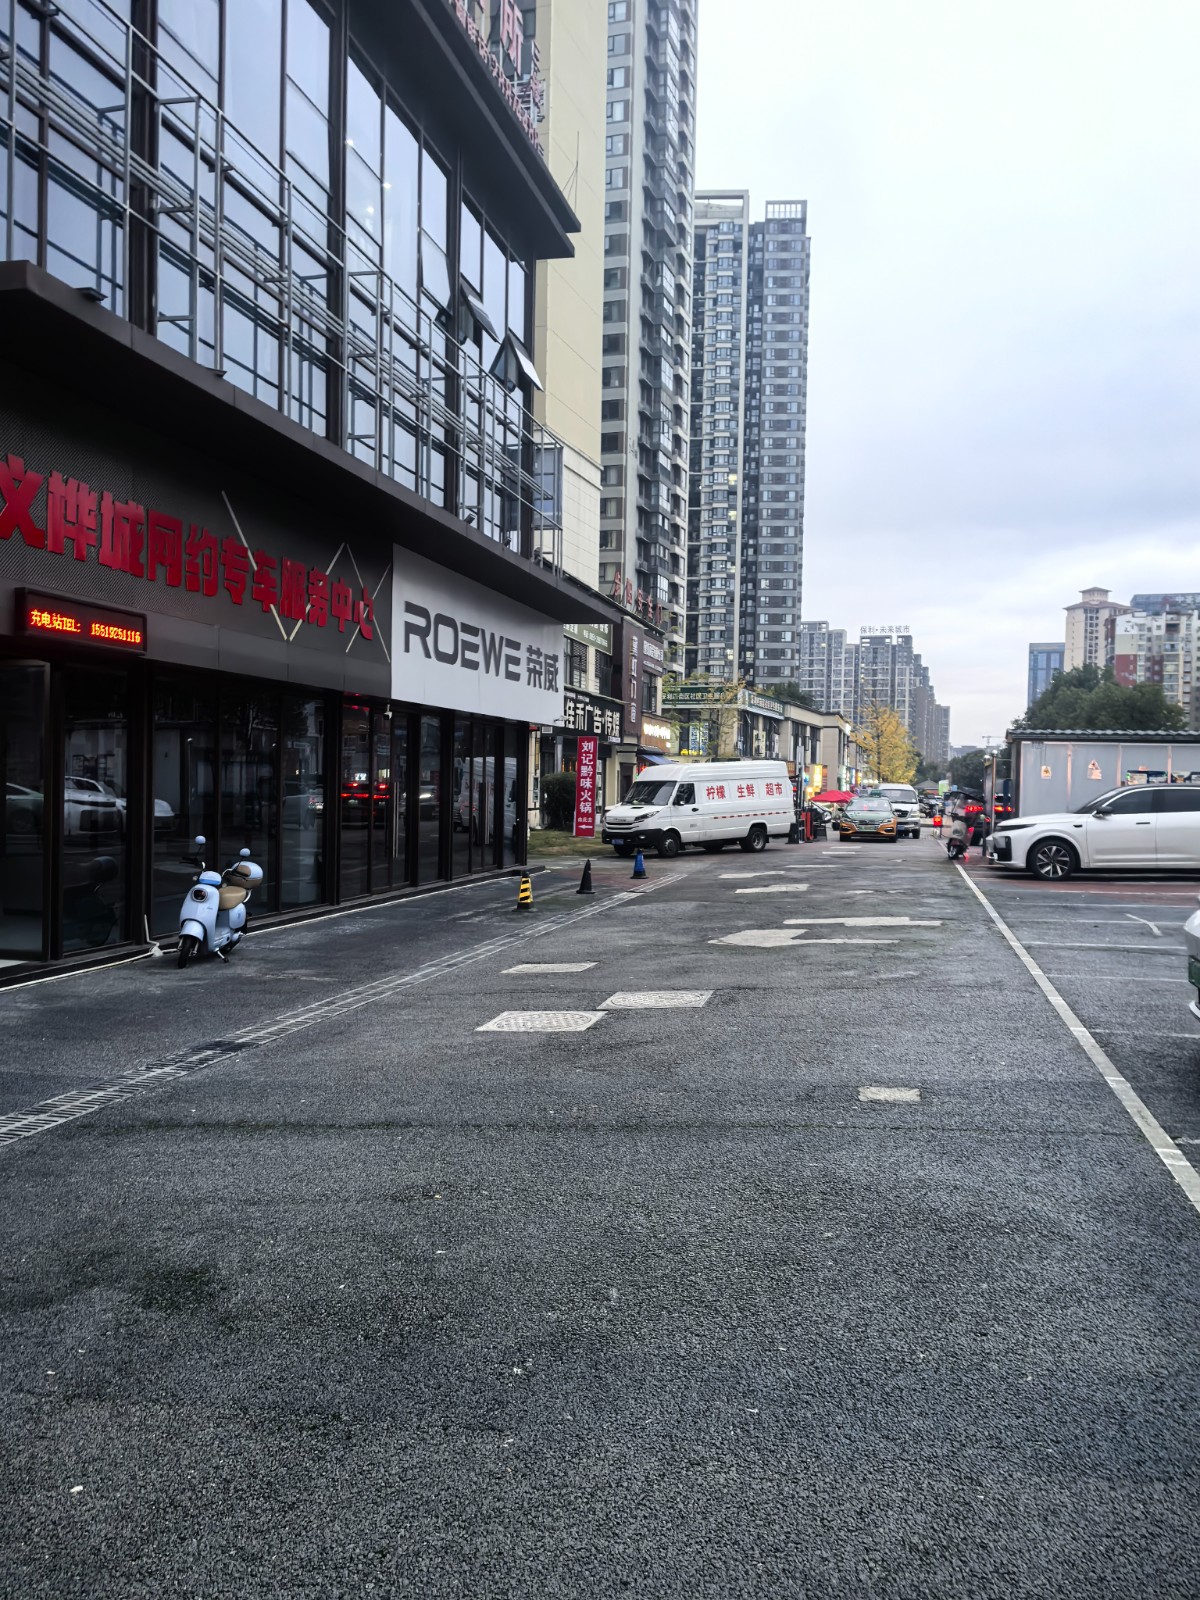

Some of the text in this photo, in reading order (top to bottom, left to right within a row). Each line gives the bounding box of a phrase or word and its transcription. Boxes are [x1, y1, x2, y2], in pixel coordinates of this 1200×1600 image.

[90, 622, 141, 643] 15519251116
[403, 600, 559, 693] ROEWE 荣威
[579, 741, 594, 813] 刘记黔味火锅
[706, 782, 782, 800] 柠檬 生鲜 超市
